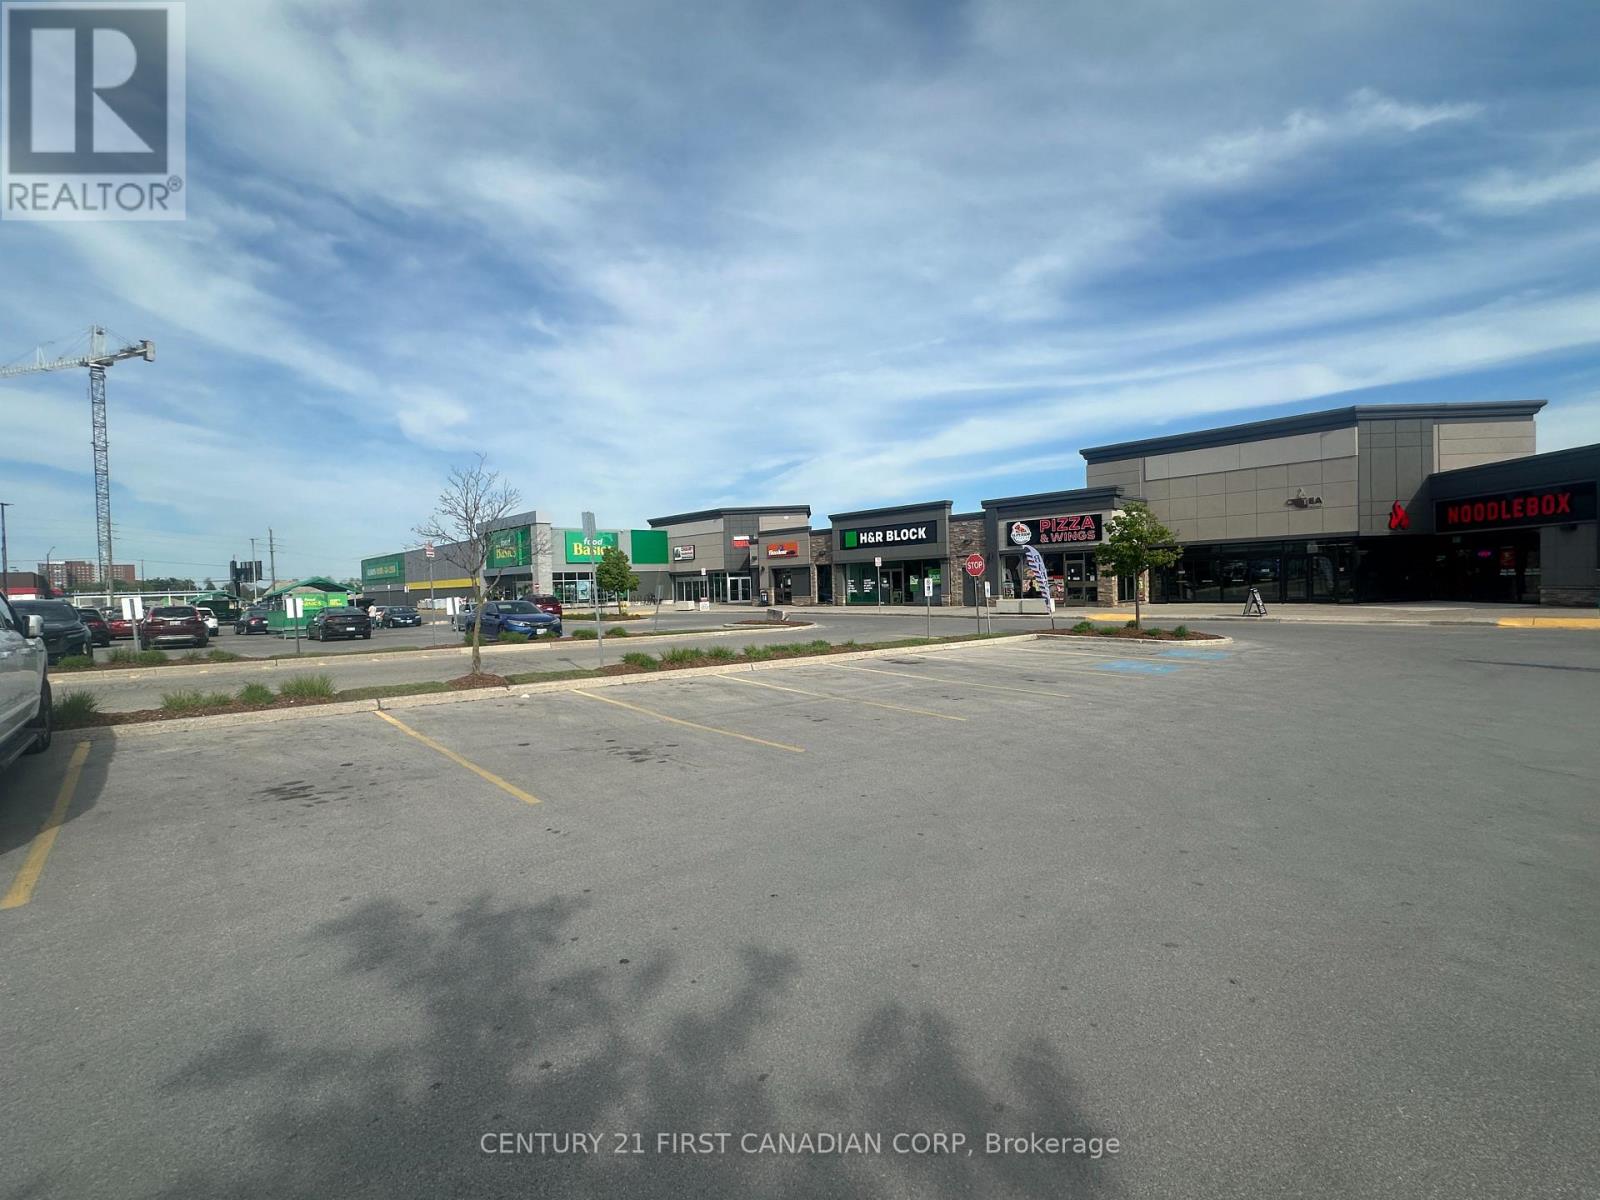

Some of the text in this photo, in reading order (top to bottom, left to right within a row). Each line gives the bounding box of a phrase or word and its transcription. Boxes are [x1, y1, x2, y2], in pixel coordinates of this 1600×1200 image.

[1447, 492, 1570, 524] NOODLEBOX
[1039, 516, 1095, 532] PIZZA
[860, 526, 927, 544] H&R BLOCK
[1040, 533, 1049, 543] &
[1050, 529, 1096, 542] WINGS
[967, 560, 983, 570] STOP
